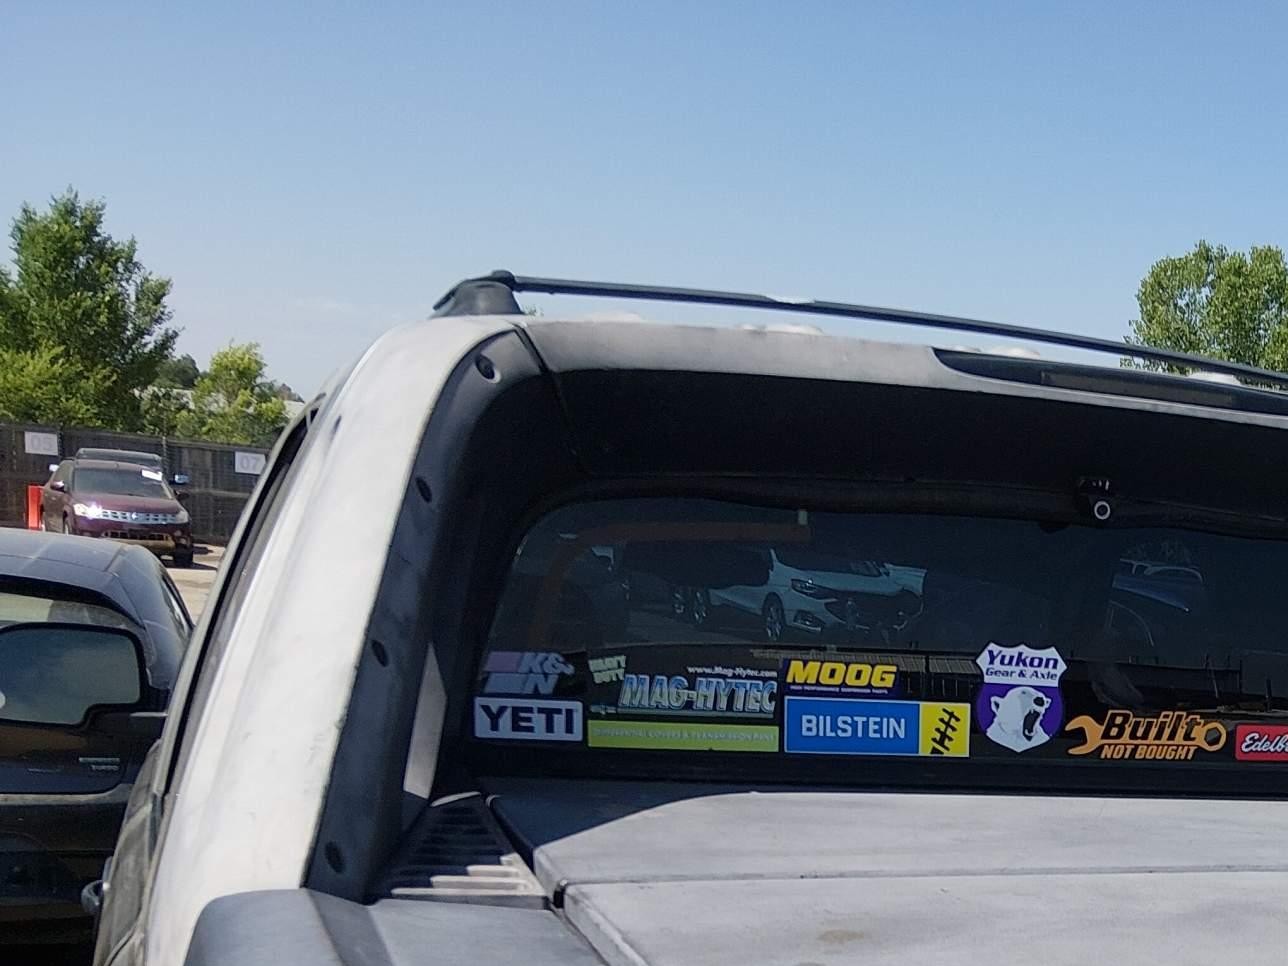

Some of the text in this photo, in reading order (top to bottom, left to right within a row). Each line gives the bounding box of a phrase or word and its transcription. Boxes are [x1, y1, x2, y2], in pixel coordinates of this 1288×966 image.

[985, 648, 1059, 670] Yukon
[785, 659, 898, 688] MOOG
[985, 666, 1058, 681] Gear & Axle
[618, 674, 778, 713] MAG-HYTEC
[480, 704, 575, 735] YETI
[801, 714, 906, 739] BILSTEIN
[1100, 710, 1205, 742] Built
[1101, 744, 1199, 761] NOT BOUGHT
